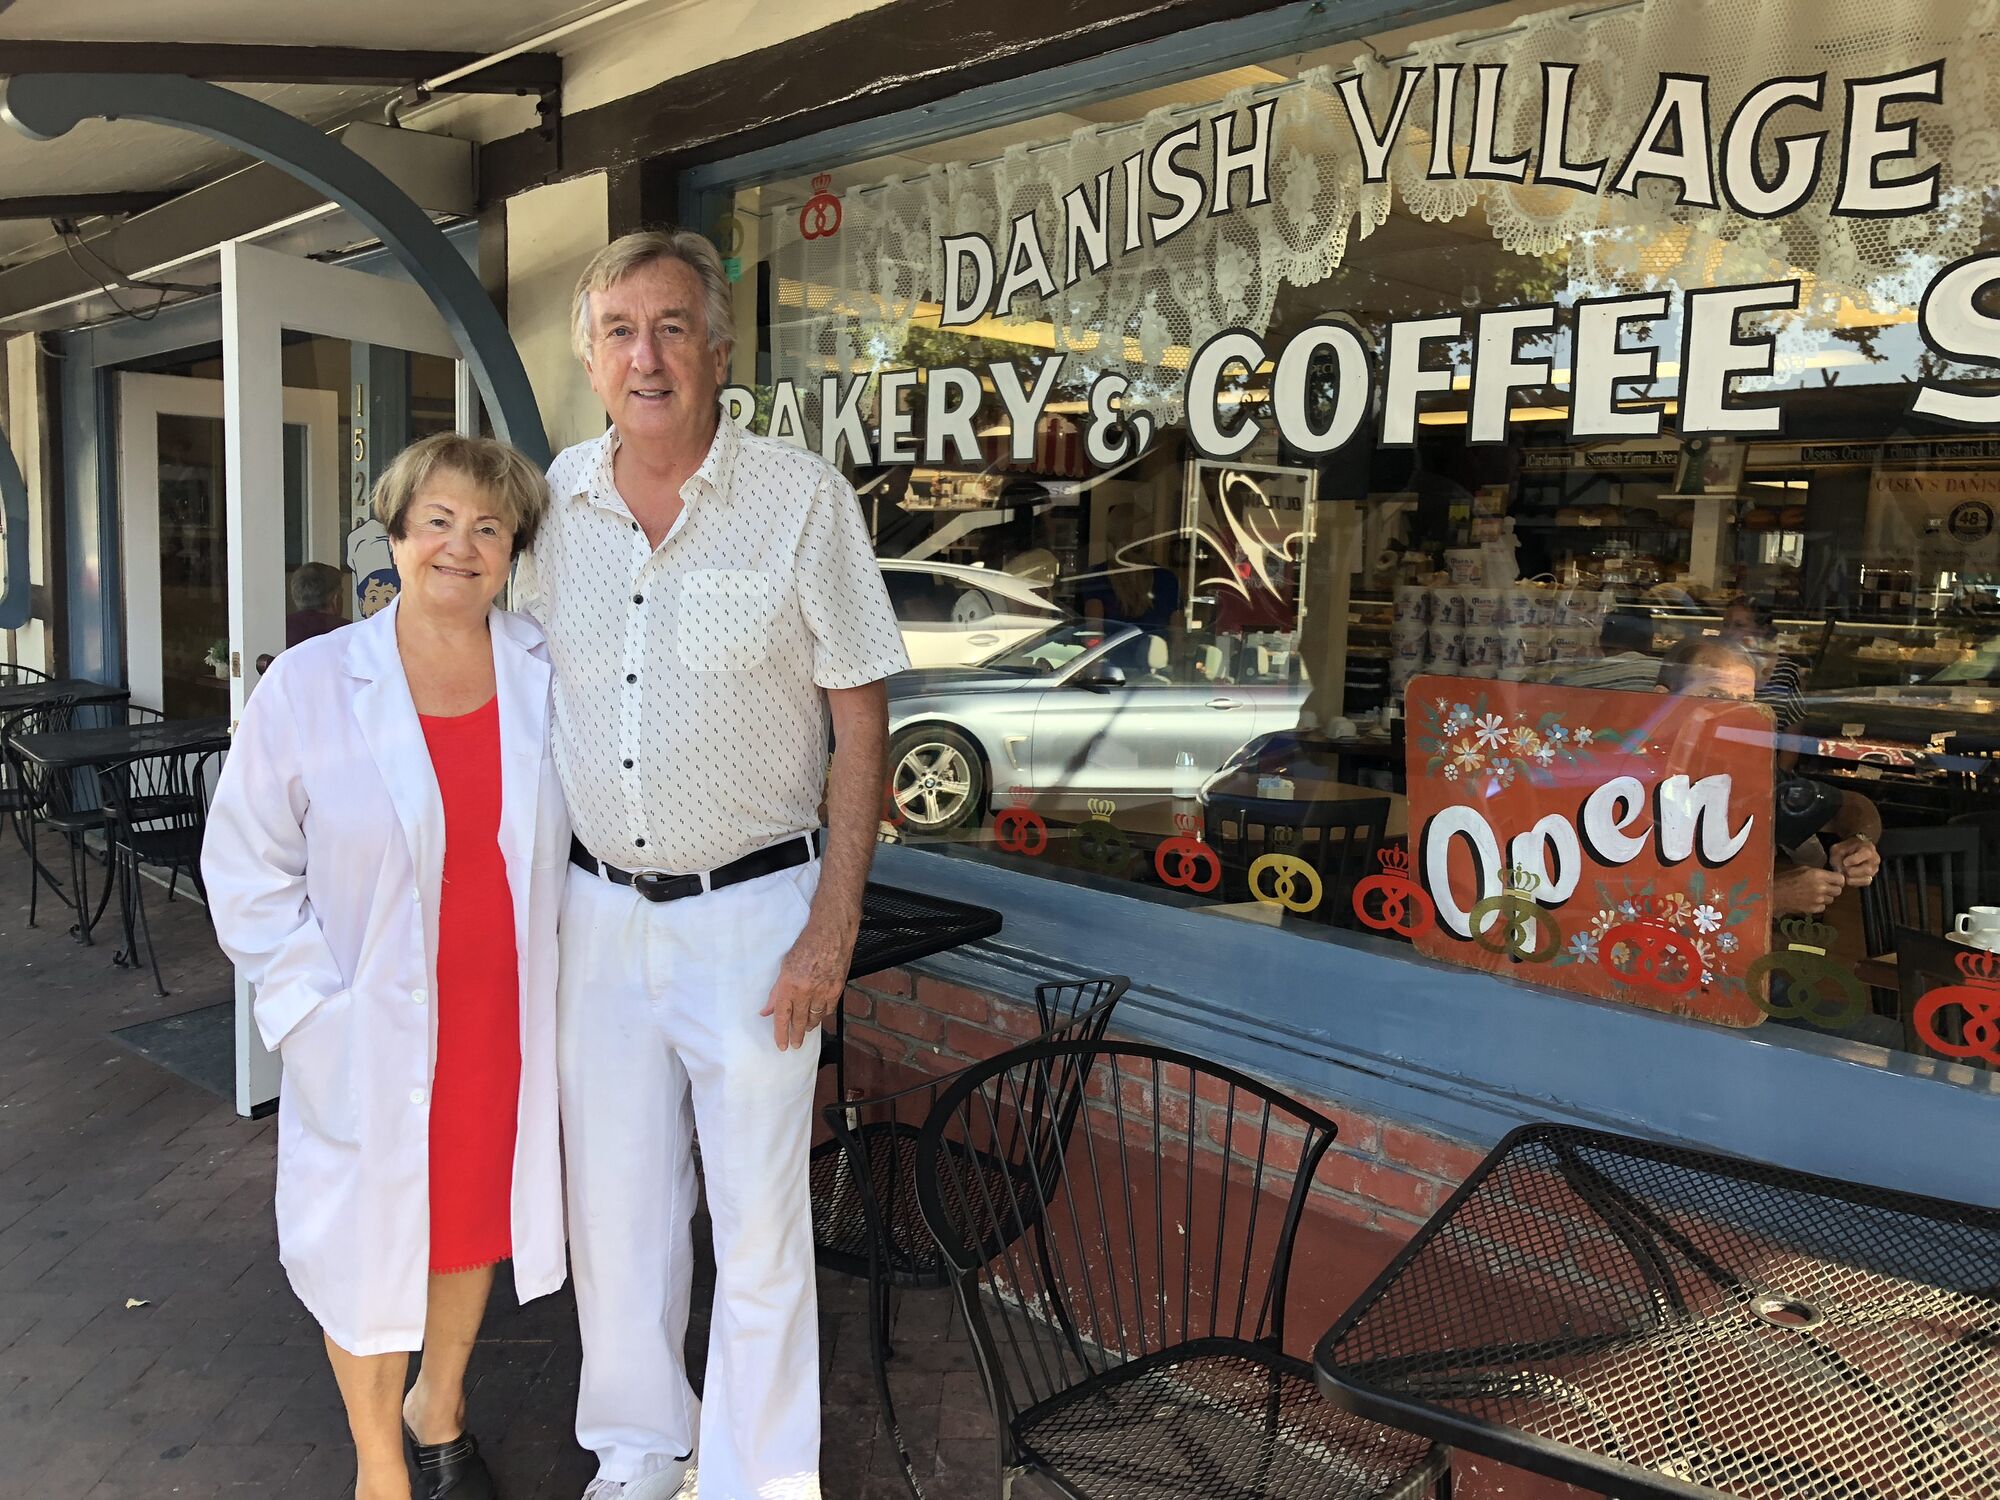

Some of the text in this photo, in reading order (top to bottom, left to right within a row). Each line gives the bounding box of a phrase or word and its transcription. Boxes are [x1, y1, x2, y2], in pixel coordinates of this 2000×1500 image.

[941, 58, 1946, 328] DANISH VILLAGE
[719, 352, 1068, 467] BAKERY
[1083, 374, 1155, 468] &
[1184, 278, 1801, 457] COFFEE
[1935, 441, 1984, 457] Custard
[1419, 772, 1755, 960] Open
